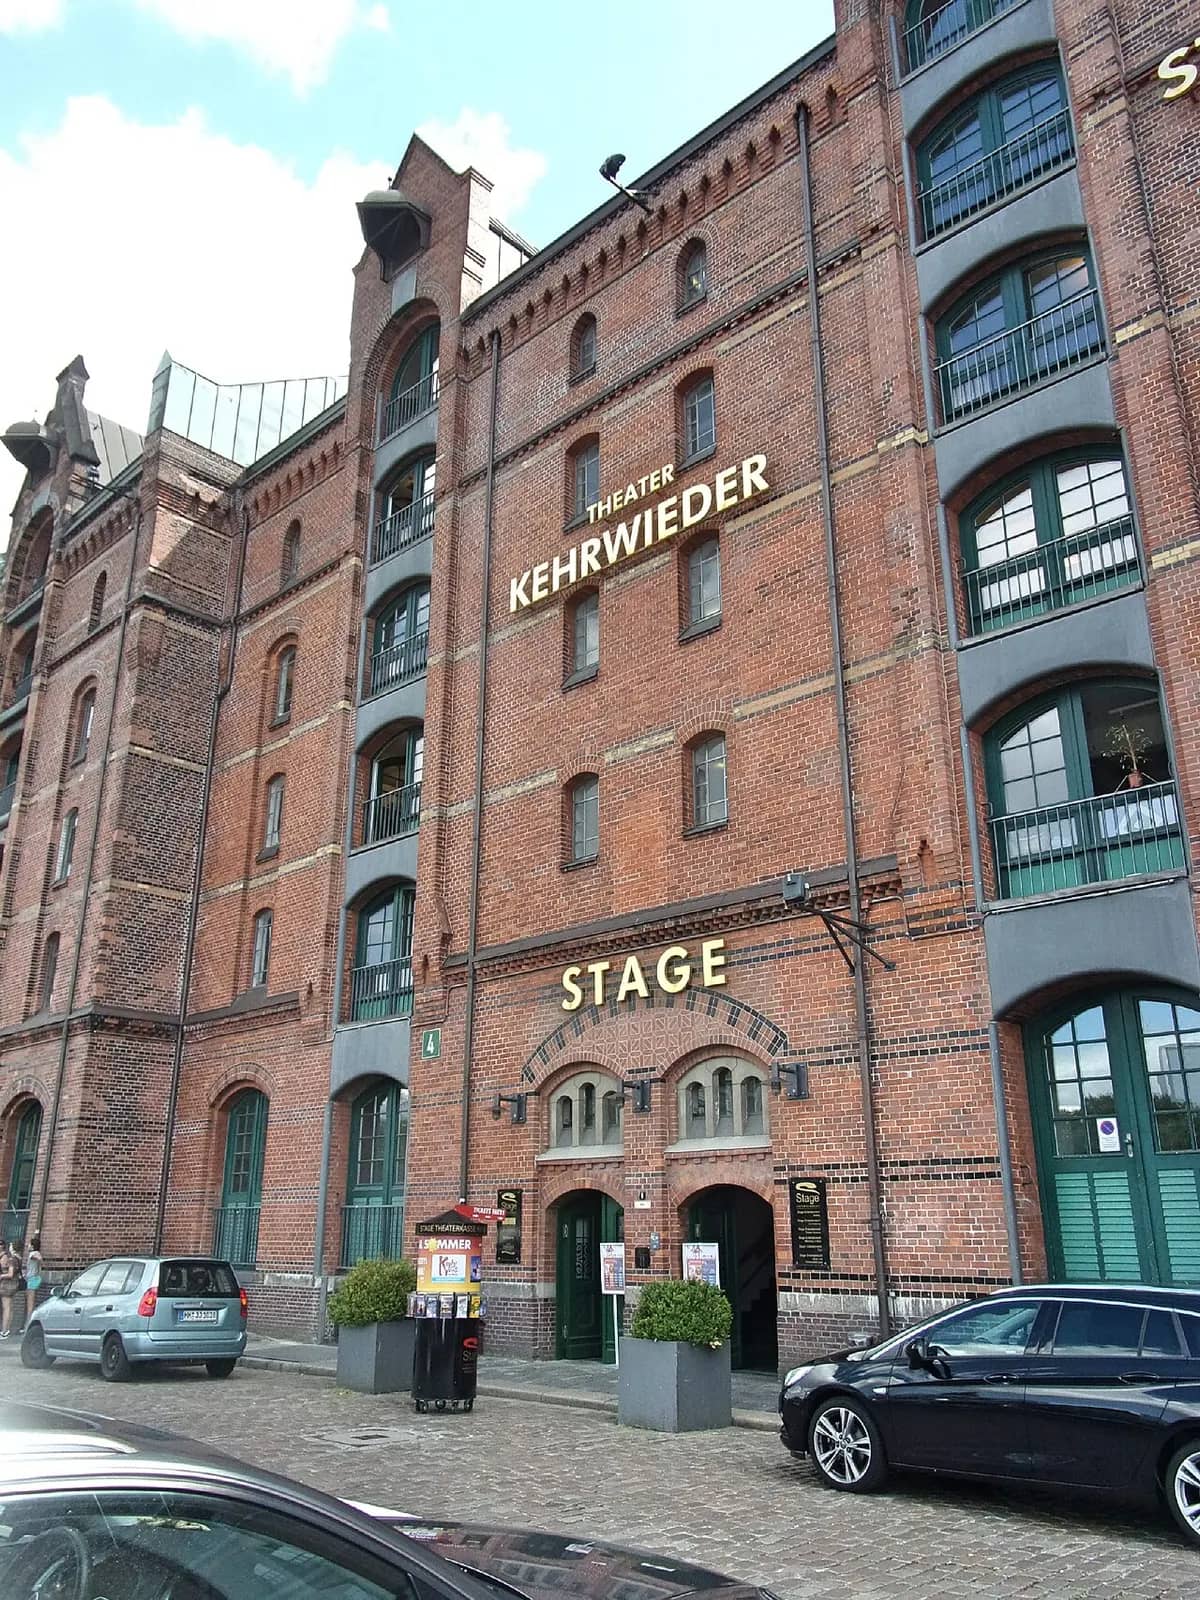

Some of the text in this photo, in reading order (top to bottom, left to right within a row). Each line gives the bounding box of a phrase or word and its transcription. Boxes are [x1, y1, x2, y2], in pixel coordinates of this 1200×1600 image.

[1158, 37, 1200, 98] S
[586, 463, 675, 524] THEATER
[509, 453, 770, 613] KEHRWIEDER
[561, 938, 727, 1011] STAGE
[426, 1033, 435, 1054] 4
[795, 1192, 820, 1204] Stage
